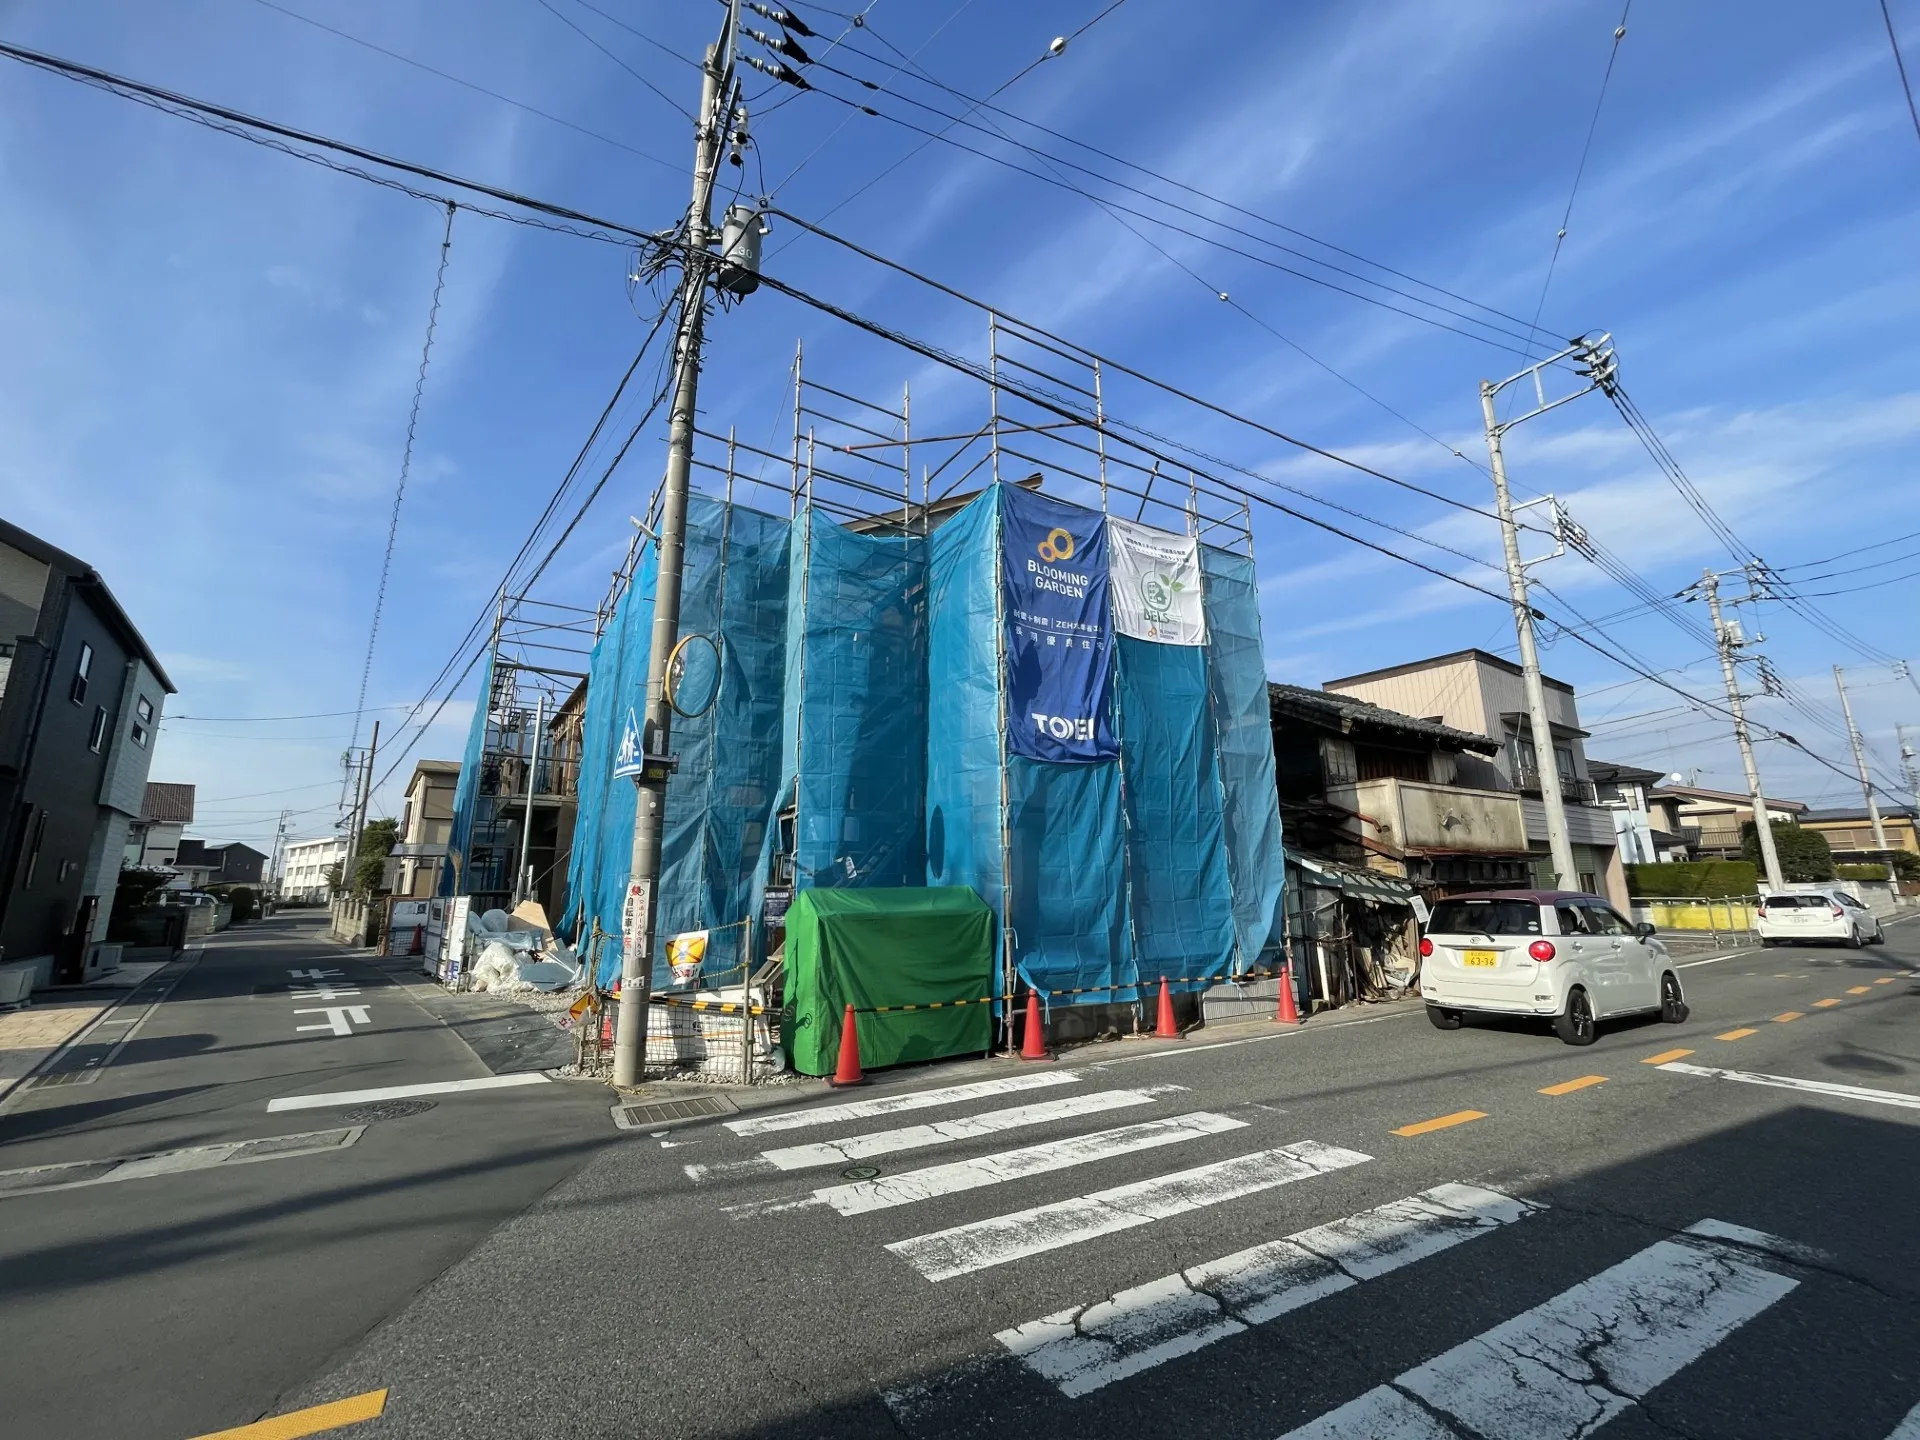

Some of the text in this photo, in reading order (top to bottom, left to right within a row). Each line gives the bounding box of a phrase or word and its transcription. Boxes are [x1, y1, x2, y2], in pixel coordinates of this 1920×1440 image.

[1027, 559, 1088, 586] BLOOMING
[1035, 576, 1083, 599] GARDEN
[1031, 713, 1094, 741] TOEI
